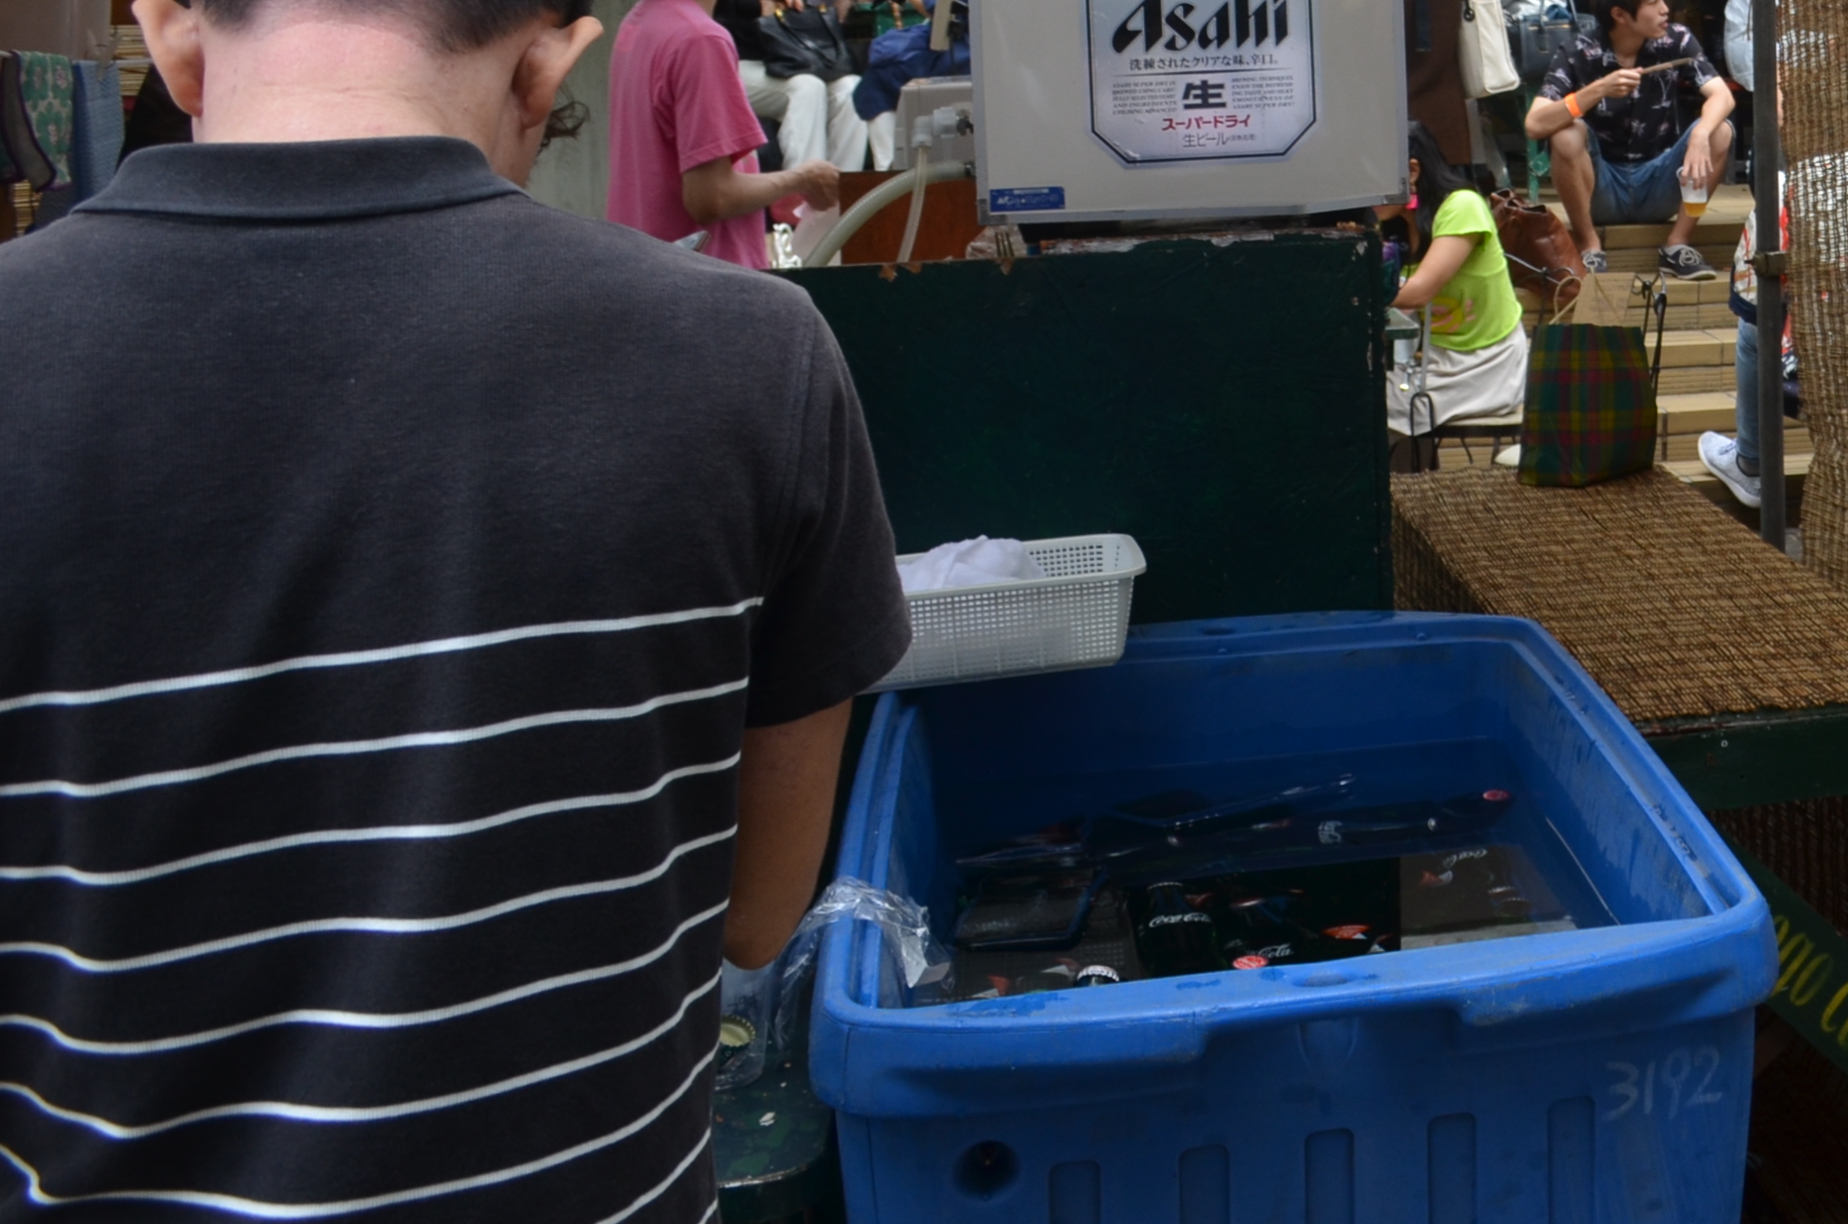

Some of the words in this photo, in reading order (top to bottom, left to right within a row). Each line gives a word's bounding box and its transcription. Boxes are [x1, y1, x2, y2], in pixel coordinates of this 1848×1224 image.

[1182, 79, 1227, 110] 生
[1162, 115, 1251, 131] スーパードライ
[1600, 1044, 1723, 1122] 3192
